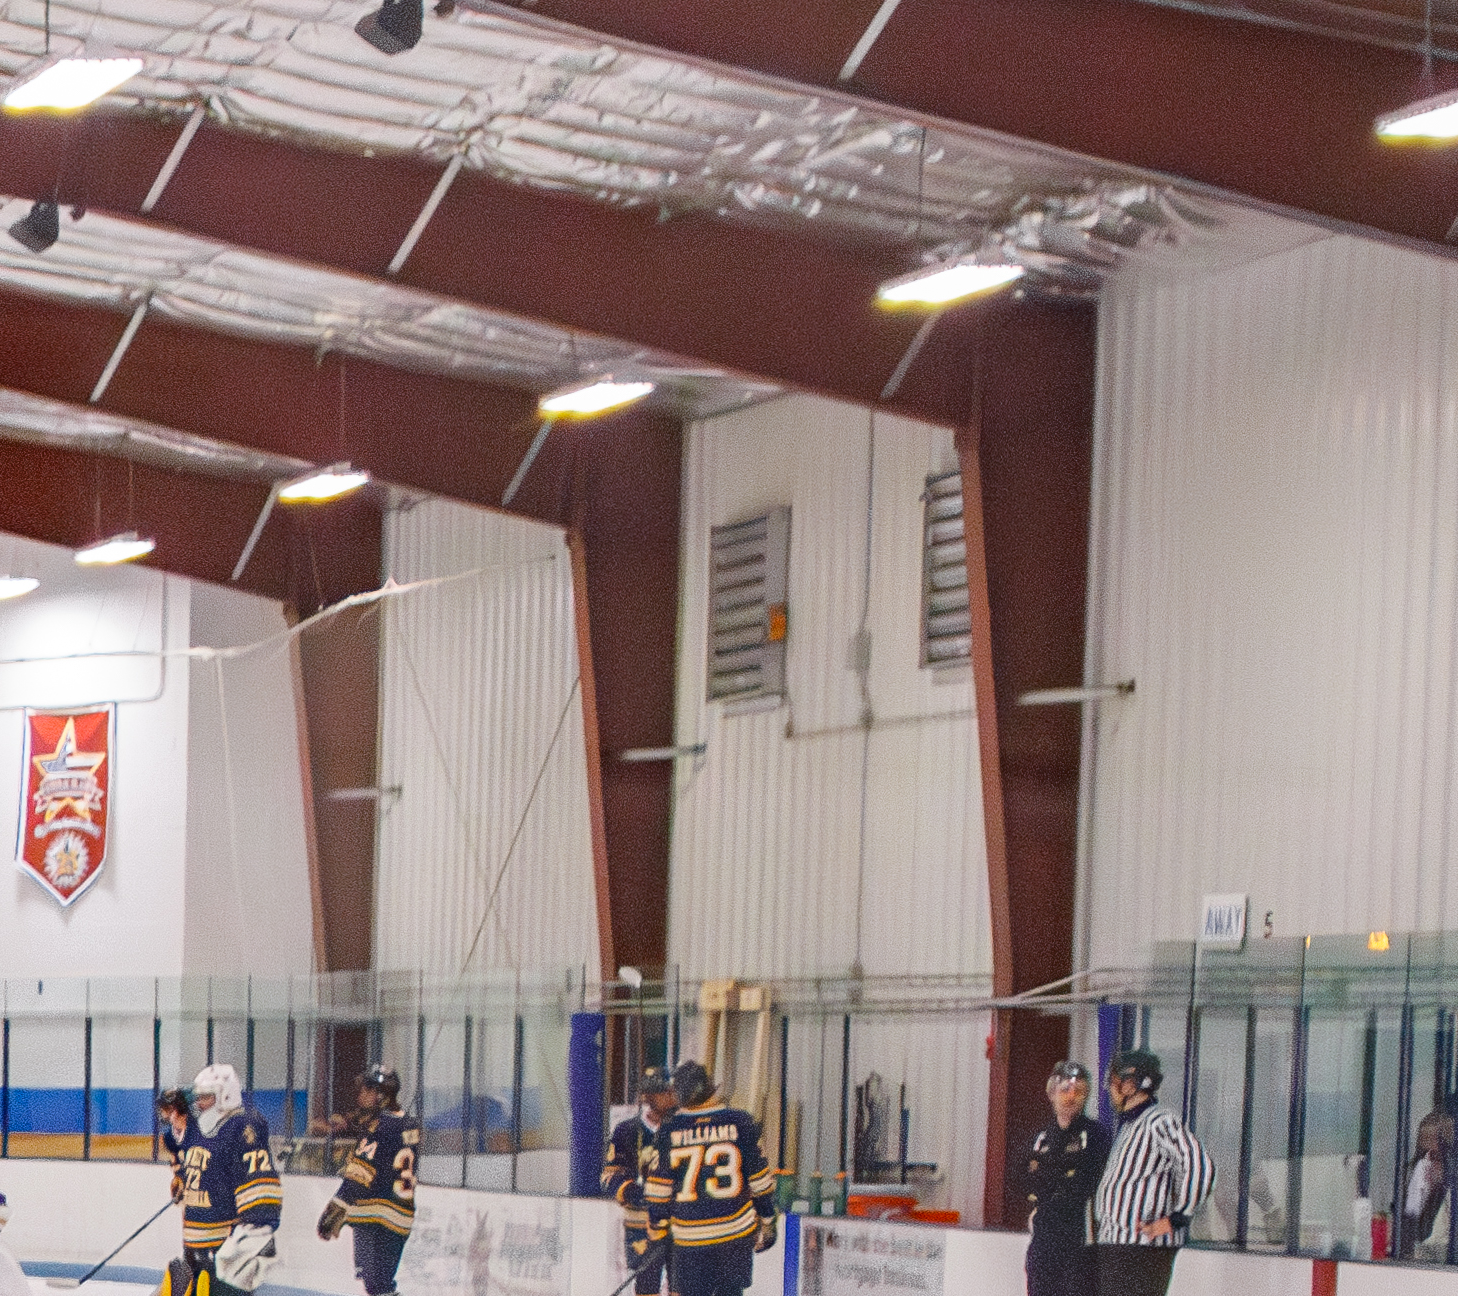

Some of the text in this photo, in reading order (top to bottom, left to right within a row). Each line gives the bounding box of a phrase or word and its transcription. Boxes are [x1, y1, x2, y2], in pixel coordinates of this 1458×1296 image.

[1204, 904, 1242, 936] AWAY
[670, 1123, 739, 1147] WILLIAMS
[242, 1149, 272, 1174] 72
[669, 1142, 744, 1202] 73
